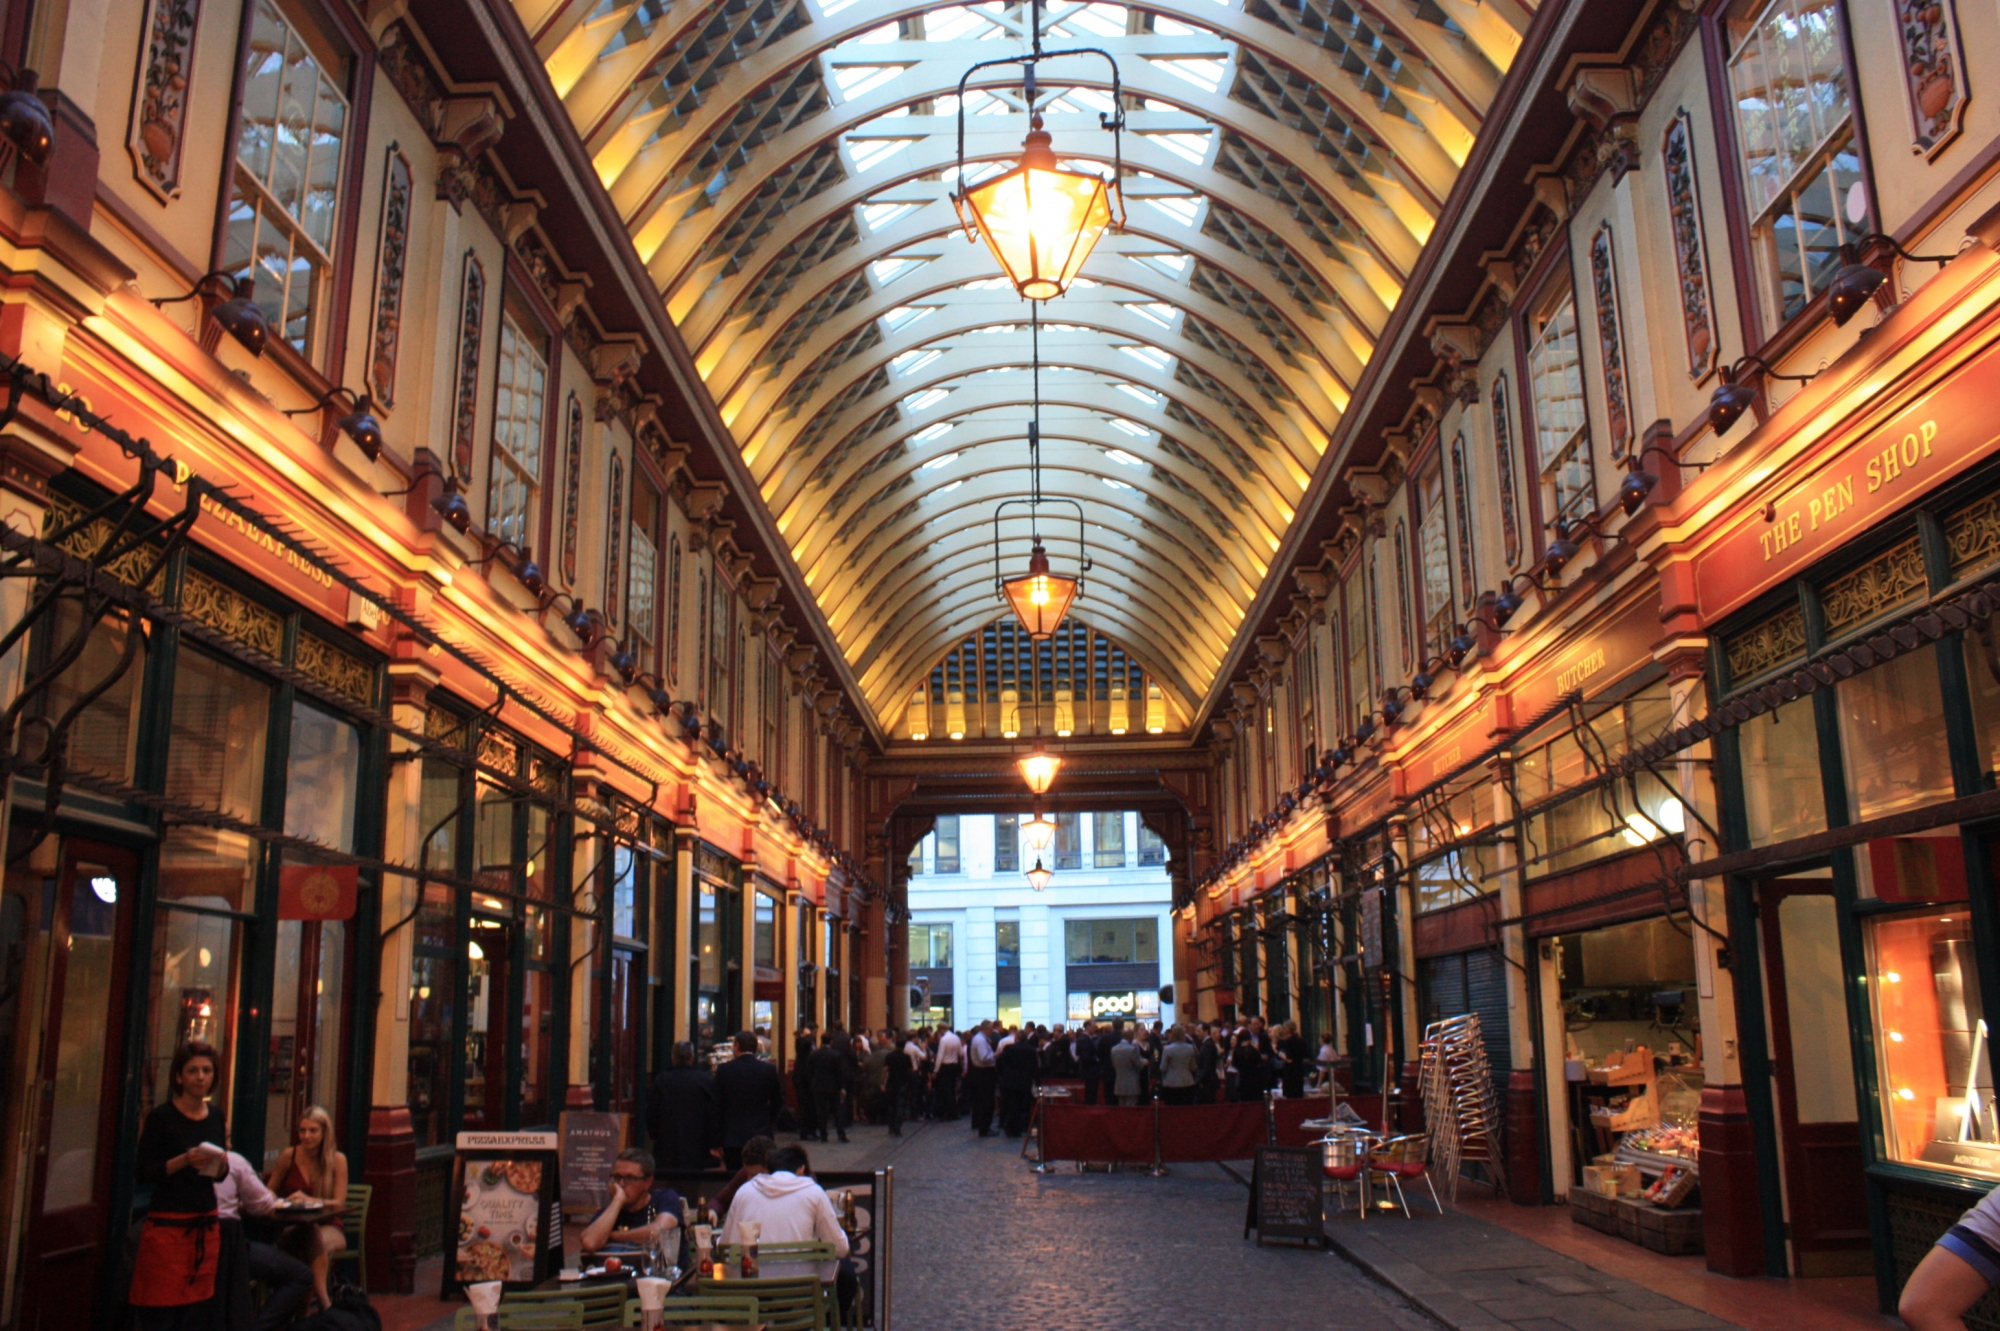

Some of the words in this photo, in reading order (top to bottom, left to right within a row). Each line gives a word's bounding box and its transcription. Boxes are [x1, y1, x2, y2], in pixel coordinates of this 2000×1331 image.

[1760, 511, 1803, 562] THE
[1808, 475, 1854, 531] PEN
[1866, 420, 1937, 494] SHOP
[173, 458, 334, 590] PZZAEXPRESS
[1556, 648, 1606, 696] BUTCHER
[1432, 746, 1461, 777] BUTCHER
[1092, 991, 1134, 1017] pod
[467, 1136, 546, 1145] PIZZAEXPRESS
[480, 1199, 524, 1210] QUALITY
